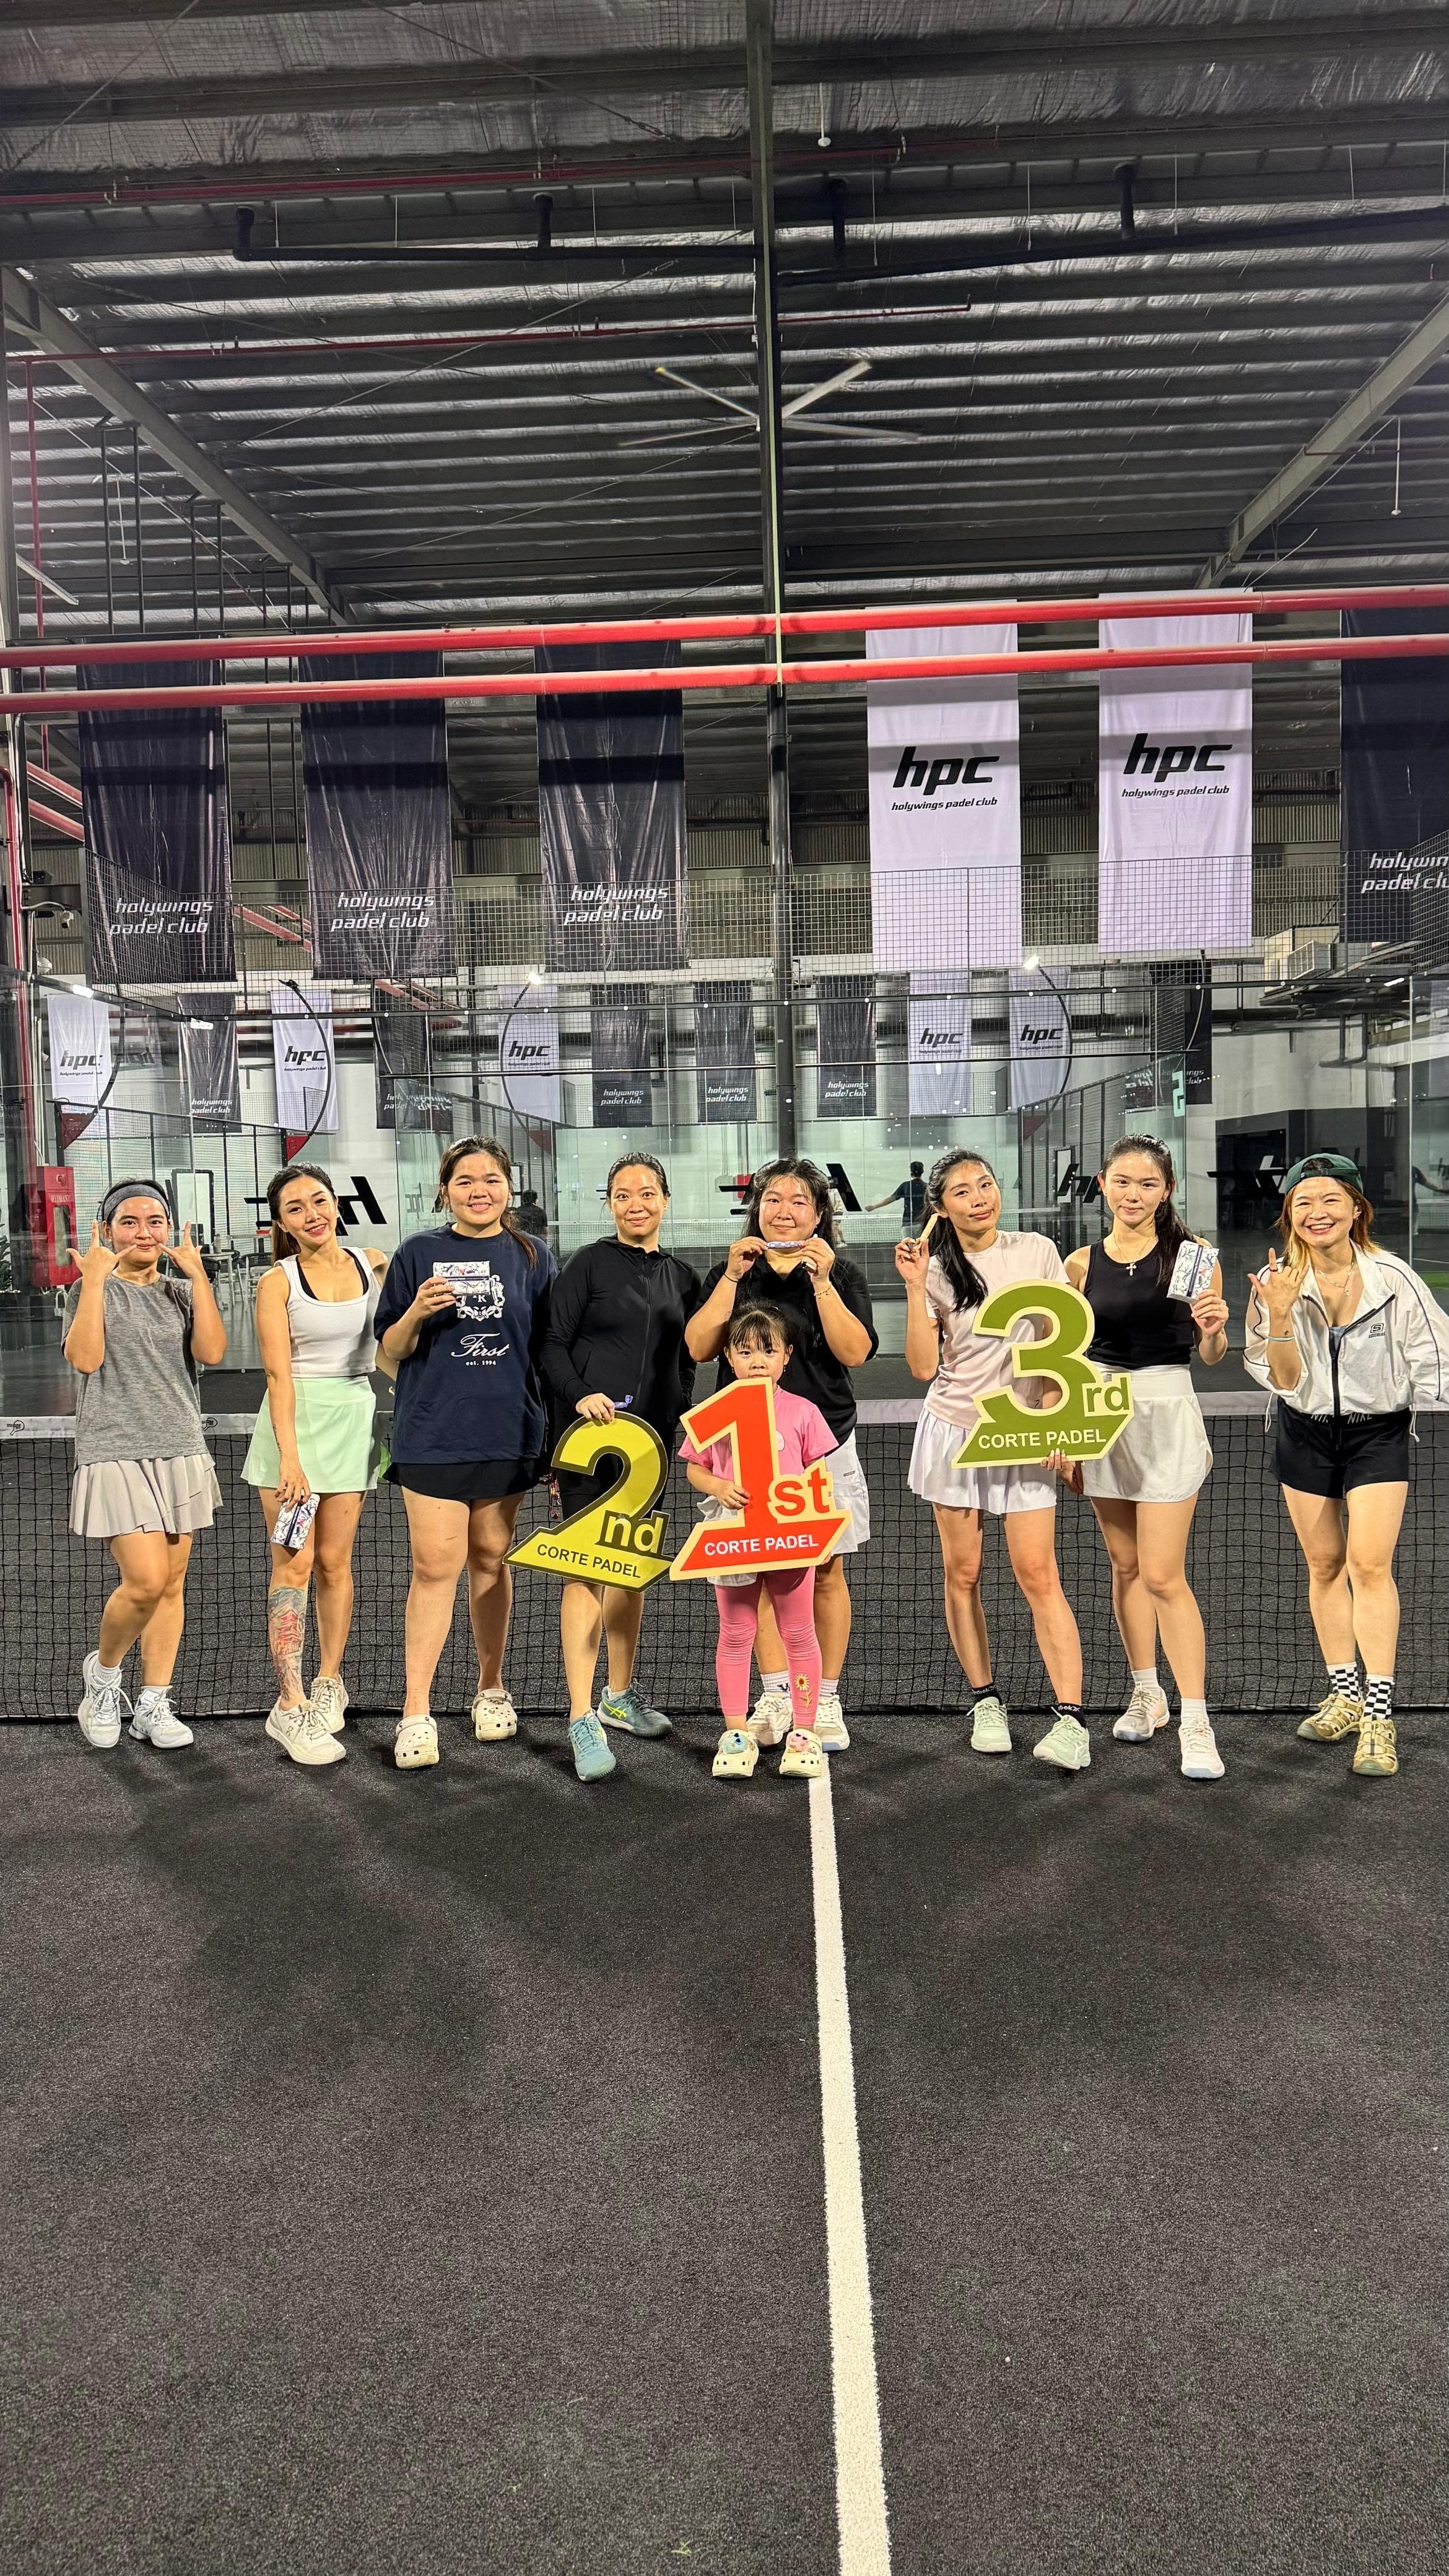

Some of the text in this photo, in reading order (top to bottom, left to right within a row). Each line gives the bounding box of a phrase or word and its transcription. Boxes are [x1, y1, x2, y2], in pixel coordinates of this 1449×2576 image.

[1123, 733, 1233, 782] hpc
[893, 746, 1000, 795] hpc
[1121, 785, 1230, 799] holywings padel club
[892, 797, 998, 812] holywings padel club
[1361, 872, 1421, 894] padel
[337, 892, 435, 911] holywings
[571, 884, 669, 904] holywings
[115, 897, 214, 916] holywings
[564, 904, 663, 925] padel club
[109, 916, 209, 936] padel club
[331, 912, 430, 932] padel club
[919, 1028, 964, 1048] hpc
[1020, 1024, 1064, 1044] hpc
[285, 1046, 326, 1065] hpc
[508, 1041, 551, 1060] hpc
[603, 1089, 645, 1098] holywings
[708, 1086, 749, 1095] holywings
[825, 1090, 848, 1099] padel
[828, 1081, 869, 1089] holywings
[191, 1098, 233, 1106] holywings
[601, 1097, 624, 1106] padel
[706, 1094, 729, 1103] padel
[451, 1333, 510, 1357] First
[981, 1286, 1129, 1422] 3rd
[978, 1429, 1107, 1449] CORTE PADEL
[688, 1384, 830, 1522] 1st
[551, 1411, 669, 1555] 2nd
[704, 1534, 819, 1556] CORTE PADEL
[537, 1544, 641, 1578] CORTE PADEL
